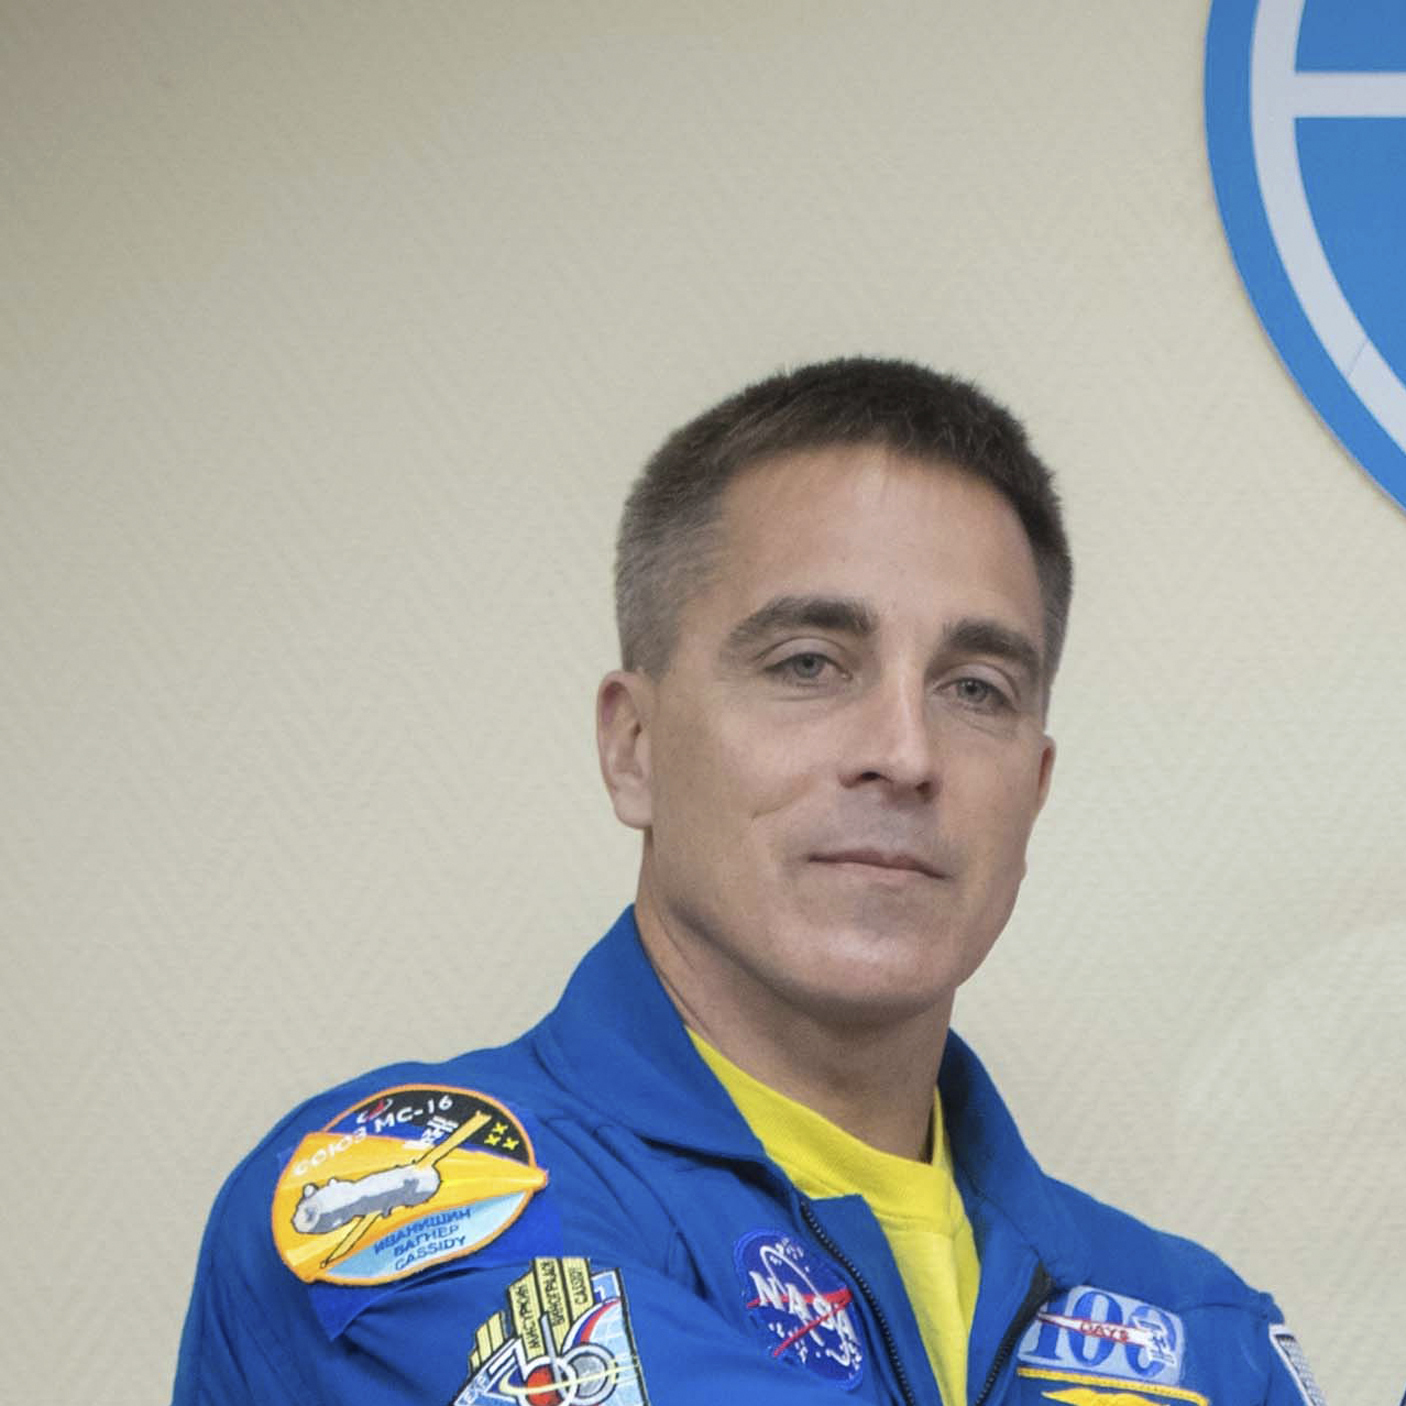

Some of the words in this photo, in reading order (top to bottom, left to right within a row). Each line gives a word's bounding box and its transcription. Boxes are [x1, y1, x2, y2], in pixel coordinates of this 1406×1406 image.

[374, 1094, 453, 1134] МС-16
[394, 1224, 460, 1258] ВАГНЕР
[395, 1235, 466, 1272] CASSIDY
[749, 1270, 861, 1347] NASA
